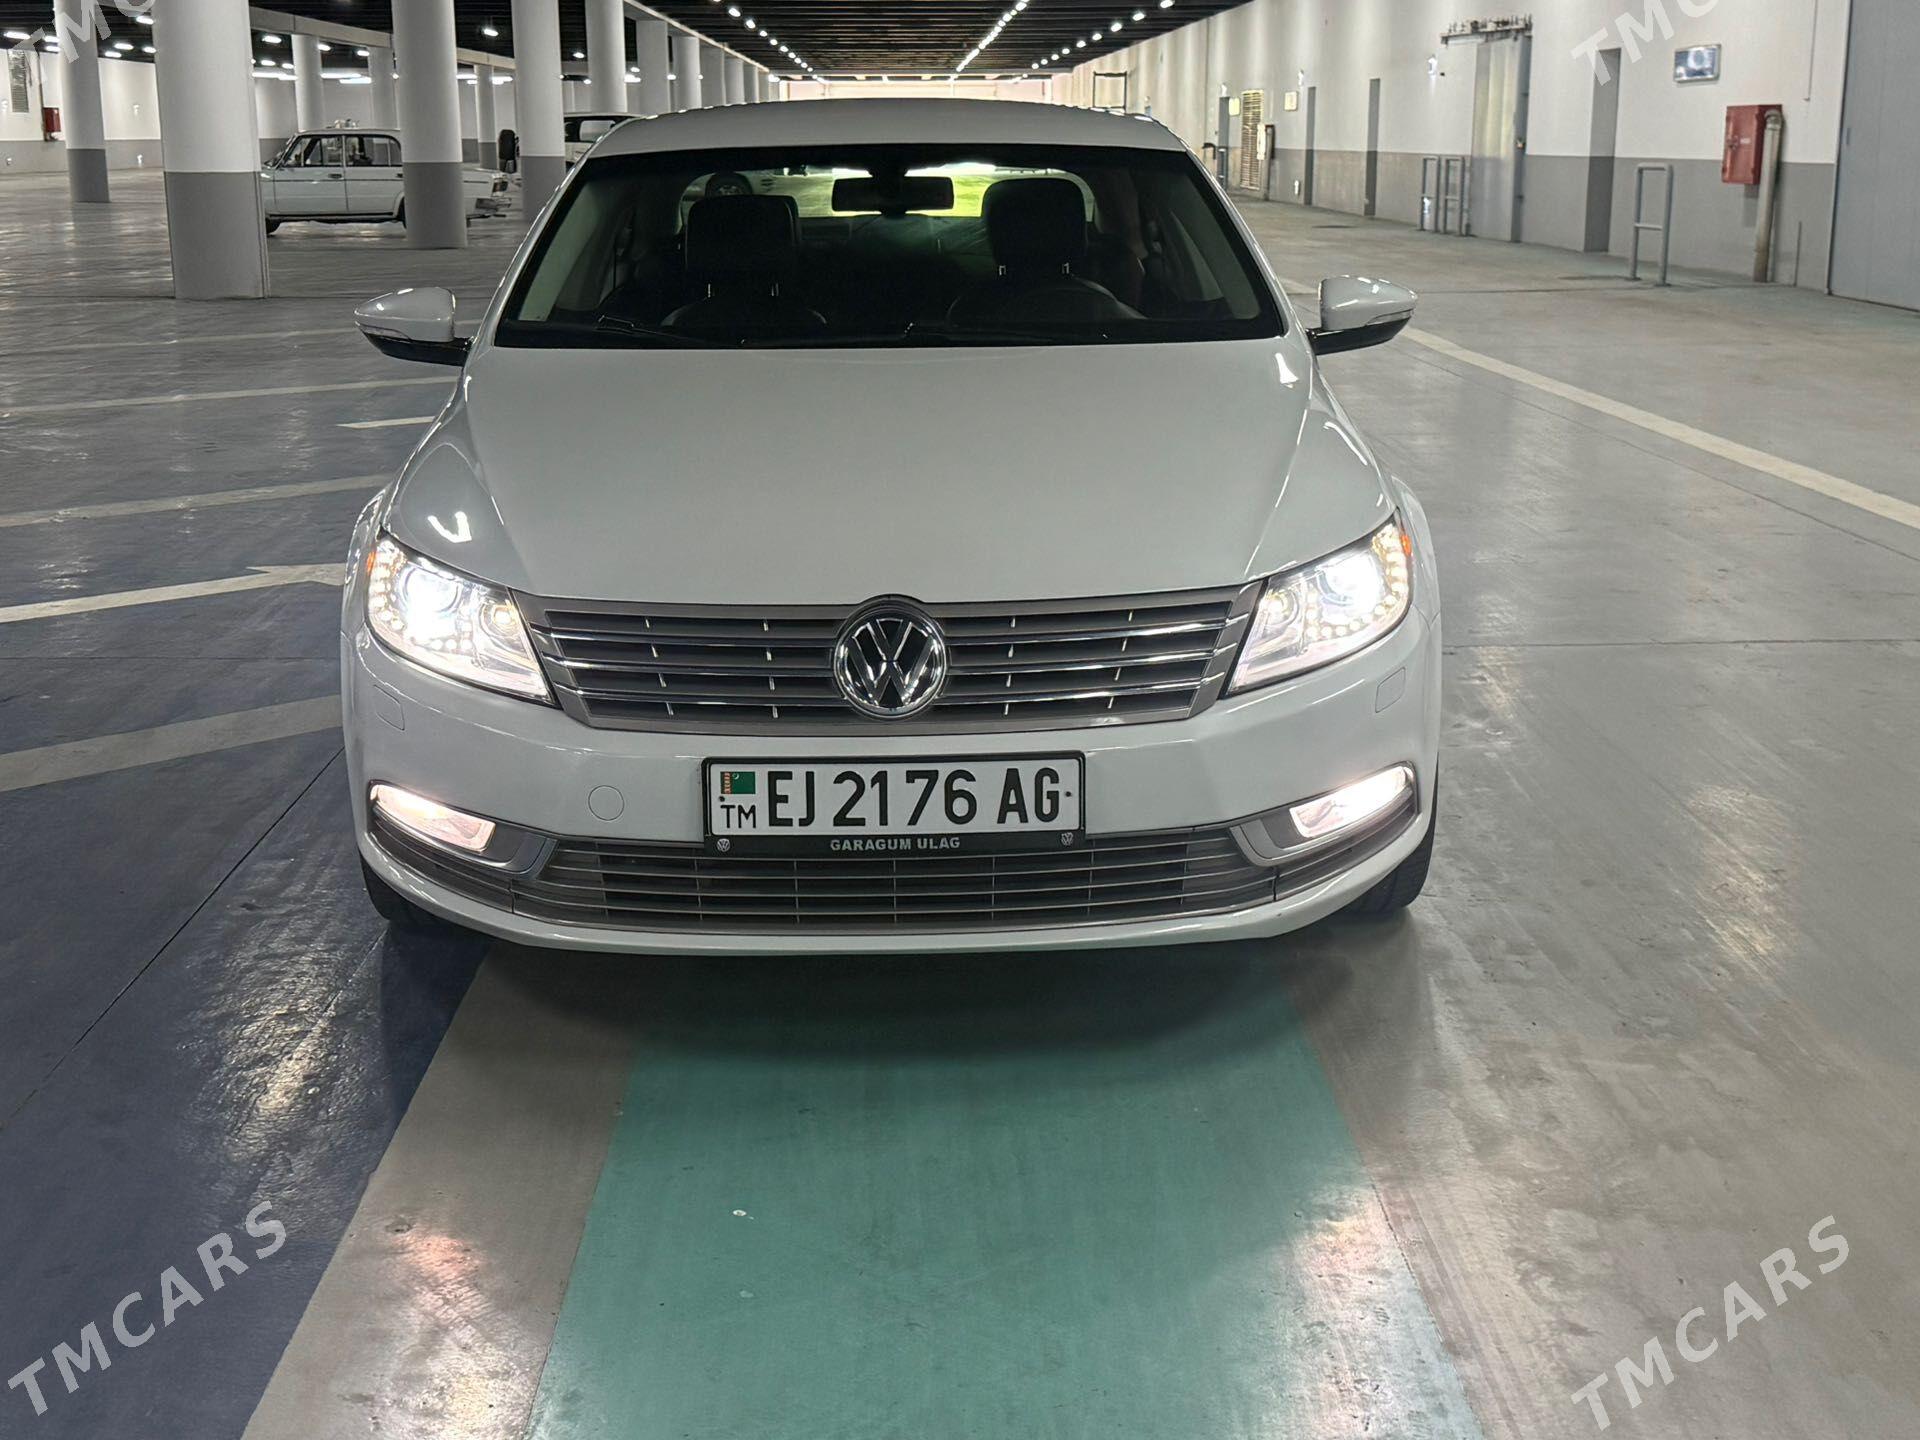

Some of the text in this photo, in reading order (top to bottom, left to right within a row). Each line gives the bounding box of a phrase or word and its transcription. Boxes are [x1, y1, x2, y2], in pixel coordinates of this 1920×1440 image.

[767, 767, 1060, 827] EJ 2176 AG
[720, 804, 757, 829] TM
[830, 837, 960, 851] GARAGUM ULAG
